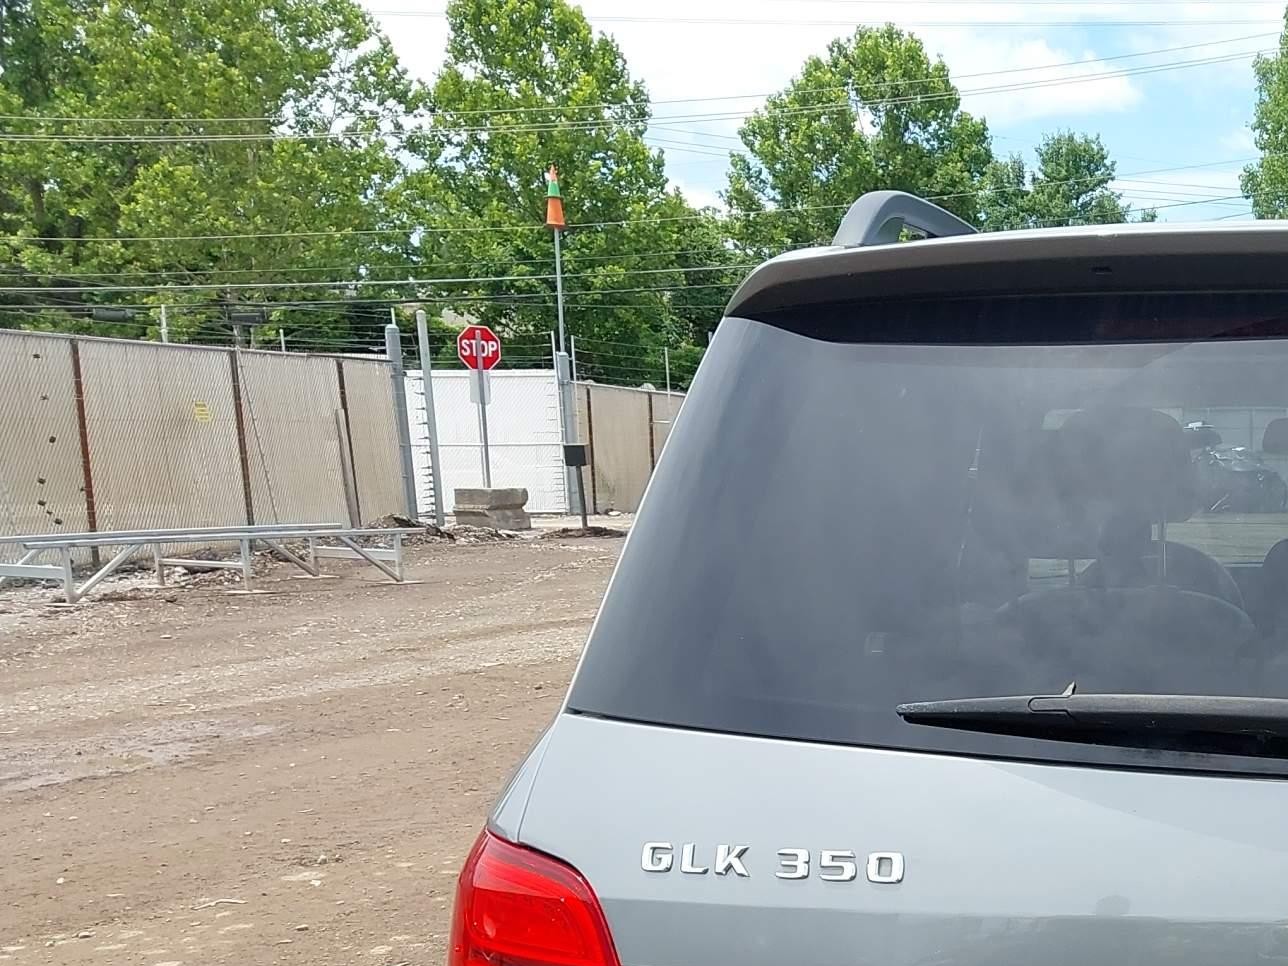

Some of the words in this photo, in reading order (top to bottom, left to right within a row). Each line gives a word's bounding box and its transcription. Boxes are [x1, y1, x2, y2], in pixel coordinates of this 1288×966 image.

[461, 339, 497, 357] STOP
[641, 842, 750, 877] GLK
[775, 848, 905, 884] 350
